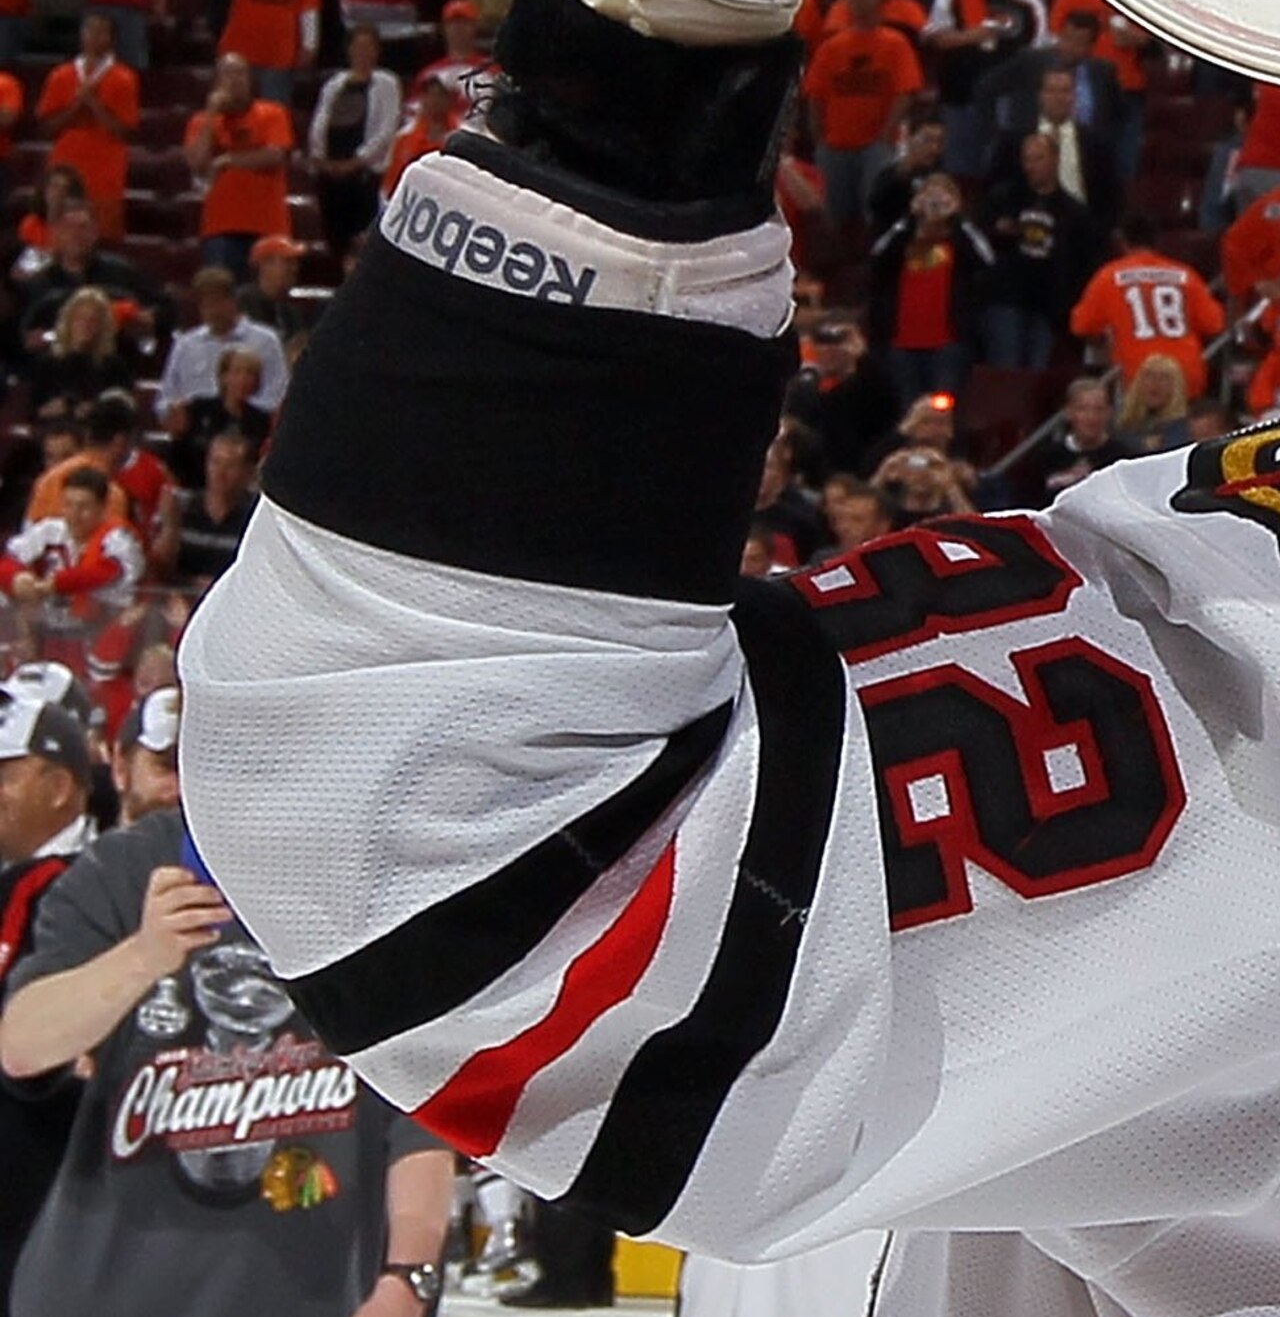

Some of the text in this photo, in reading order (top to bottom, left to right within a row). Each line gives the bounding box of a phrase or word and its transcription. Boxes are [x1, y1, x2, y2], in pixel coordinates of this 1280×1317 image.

[388, 184, 597, 306] Reebok
[1124, 285, 1186, 339] 18
[111, 1064, 358, 1158] Champions
